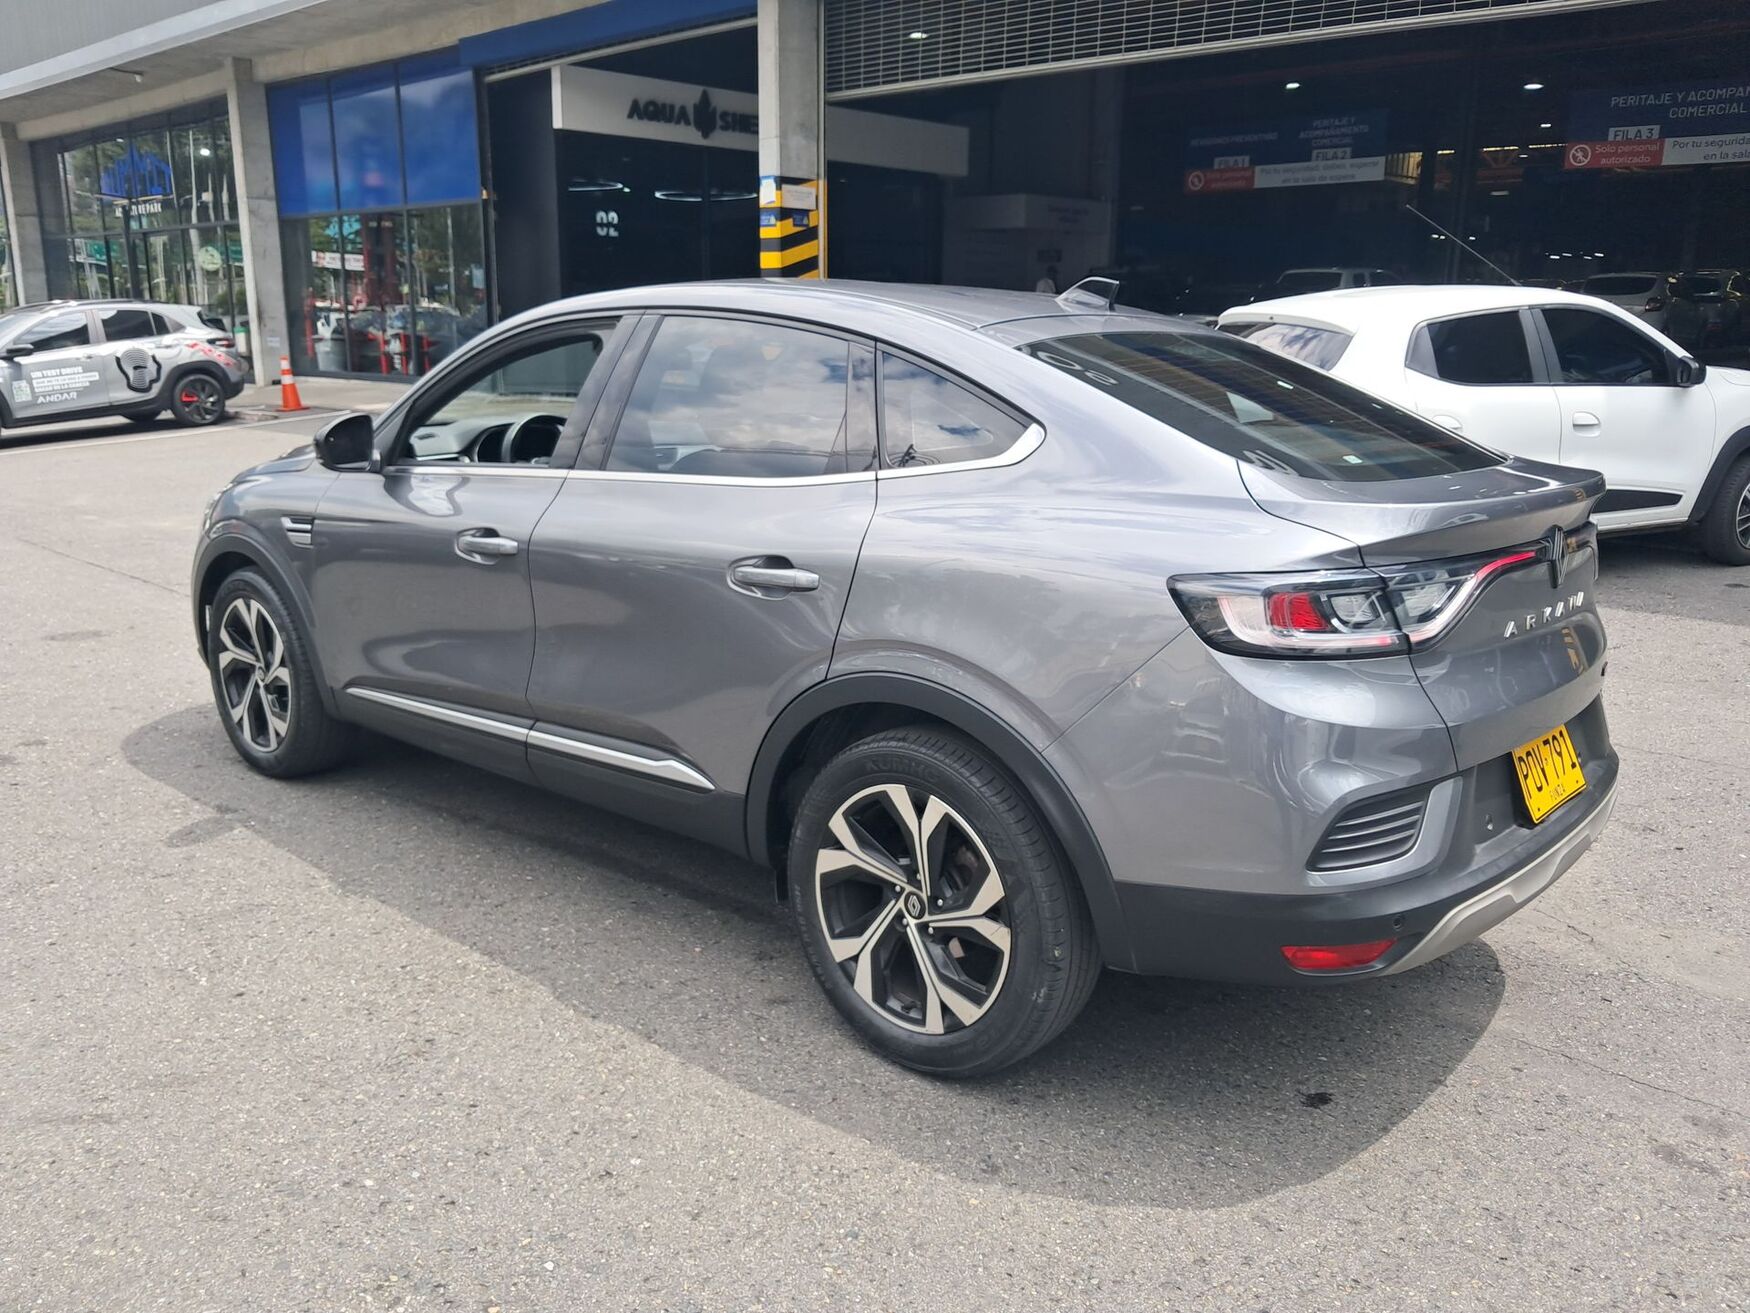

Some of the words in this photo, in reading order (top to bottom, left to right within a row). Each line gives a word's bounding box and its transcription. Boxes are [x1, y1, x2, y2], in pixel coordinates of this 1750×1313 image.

[1610, 93, 1673, 107] PERITAJE
[1677, 91, 1686, 103] Y
[627, 98, 691, 127] AQUA
[1669, 102, 1748, 119] COMERCIAL
[1614, 129, 1642, 141] FILA
[1646, 128, 1655, 139] 3
[1618, 143, 1660, 155] personal
[1672, 140, 1689, 149] Por
[1691, 139, 1702, 148] tu
[1316, 150, 1339, 160] FILA
[1341, 149, 1349, 159] 2
[1600, 155, 1652, 165] autorizado
[1703, 153, 1717, 161] en
[1720, 151, 1729, 160] la
[596, 210, 619, 238] 02
[37, 391, 77, 404] ANDAR
